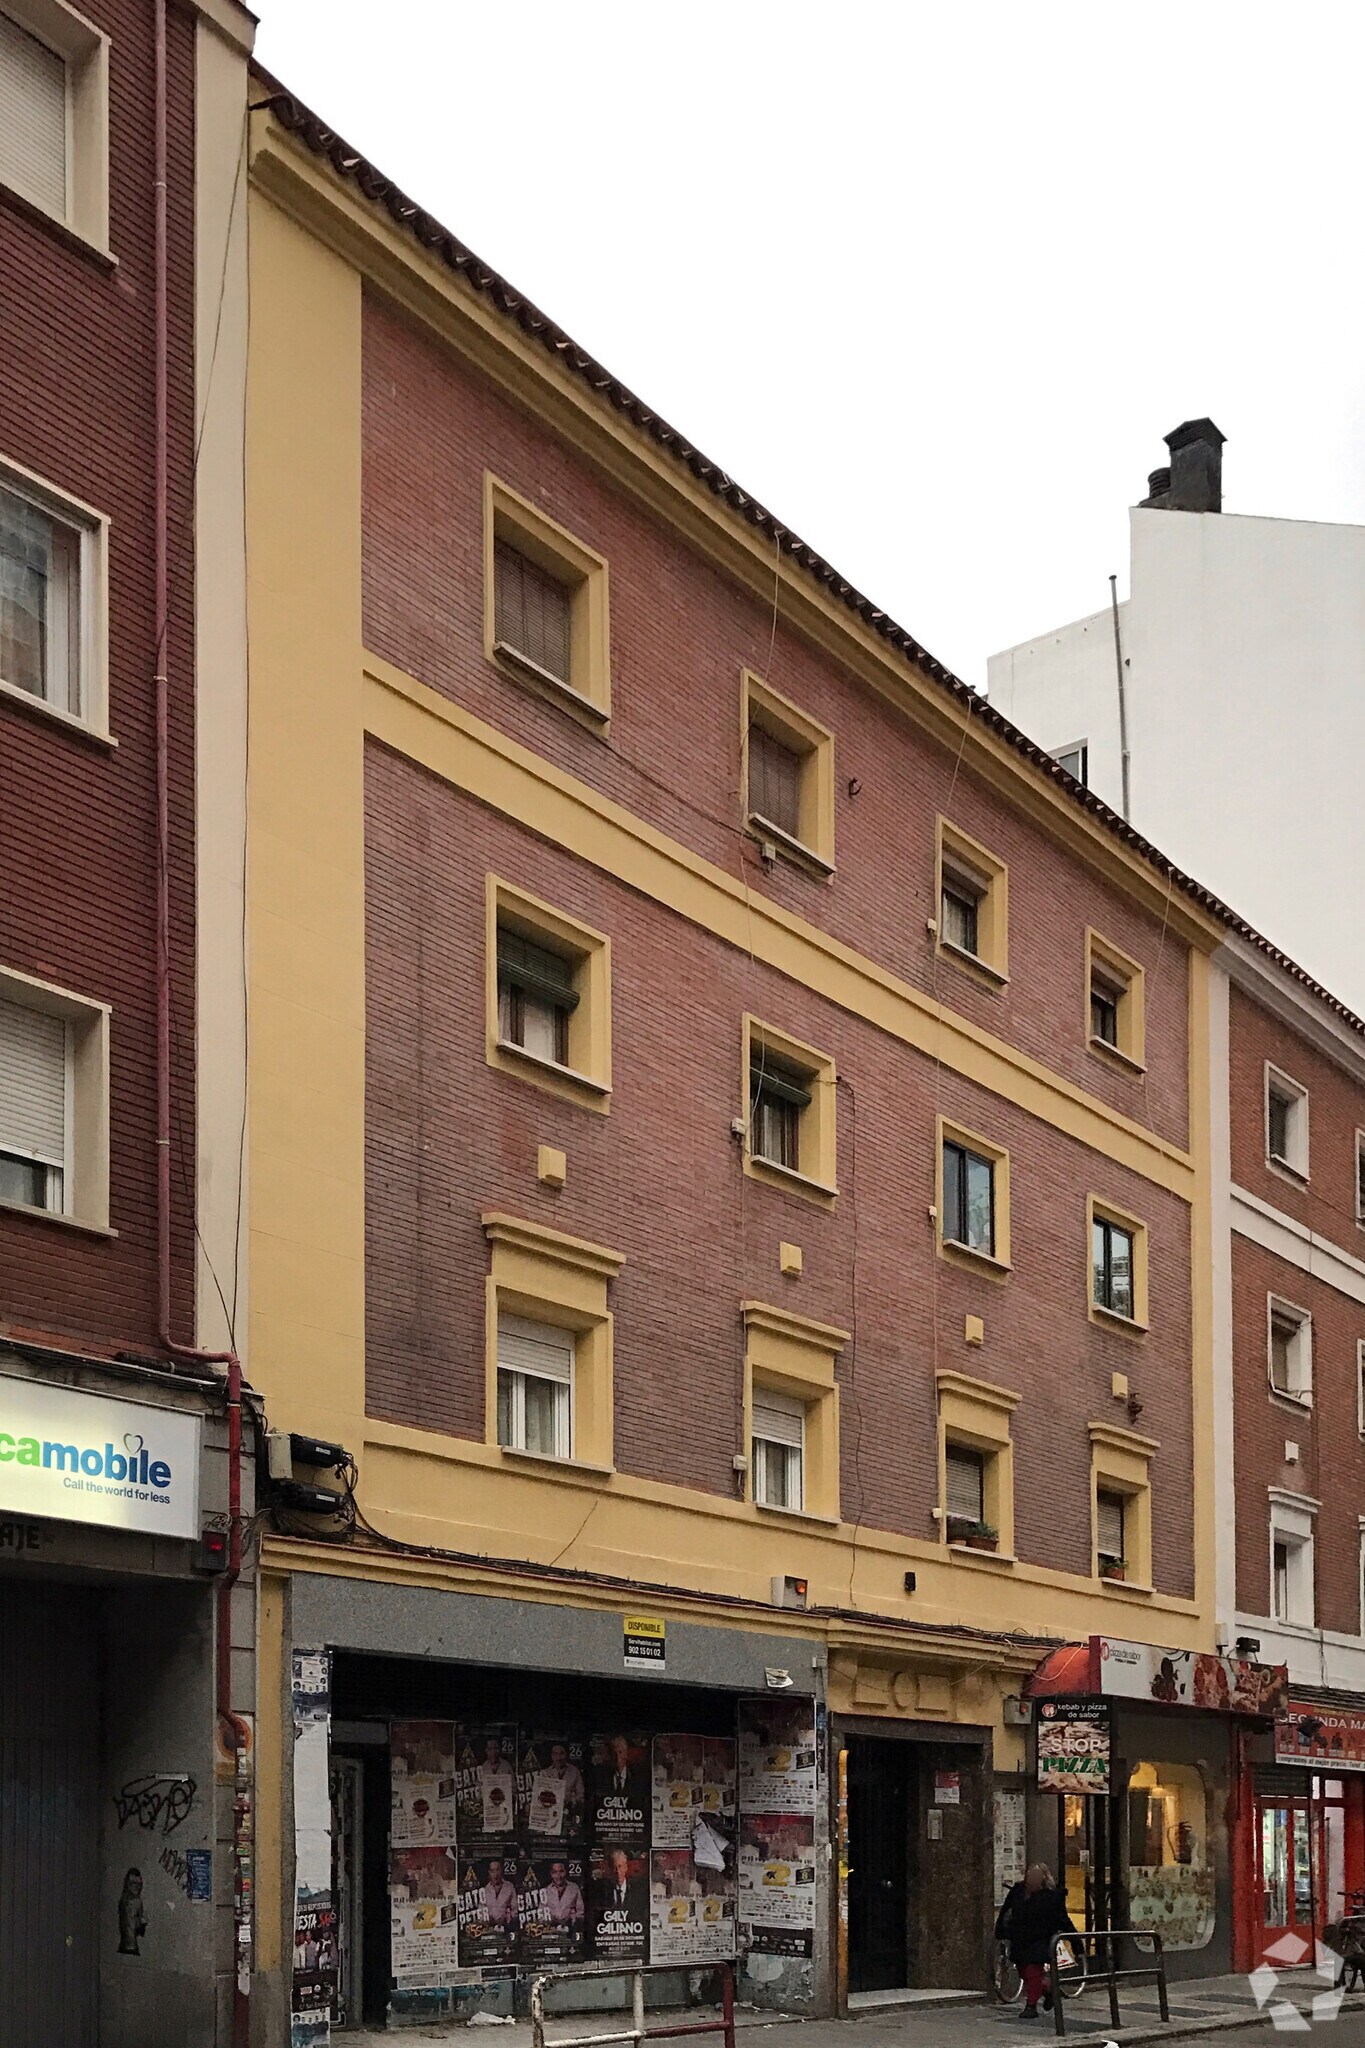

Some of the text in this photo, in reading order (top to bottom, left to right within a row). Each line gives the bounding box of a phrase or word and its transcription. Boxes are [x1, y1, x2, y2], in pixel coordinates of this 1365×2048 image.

[0, 1433, 171, 1488] camobile
[63, 1477, 170, 1504] Call the world for less
[628, 1621, 661, 1633] DISPONIBLE
[628, 1646, 639, 1654] 902
[640, 1647, 646, 1655] 15
[653, 1649, 661, 1657] 02
[502, 1740, 514, 1752] 26
[1051, 1738, 1101, 1752] STOP
[569, 1746, 582, 1757] 26
[1042, 1757, 1107, 1774] PIZZA
[603, 1797, 628, 1808] GALY
[597, 1809, 643, 1820] GALIANO
[504, 1861, 517, 1873] 26
[568, 1863, 582, 1874] 26
[458, 1887, 487, 1912] GATO
[517, 1888, 548, 1911] GATO
[459, 1907, 489, 1930] PETER
[518, 1907, 551, 1929] PETER
[603, 1910, 628, 1922] GALY
[597, 1922, 643, 1934] GALIANO
